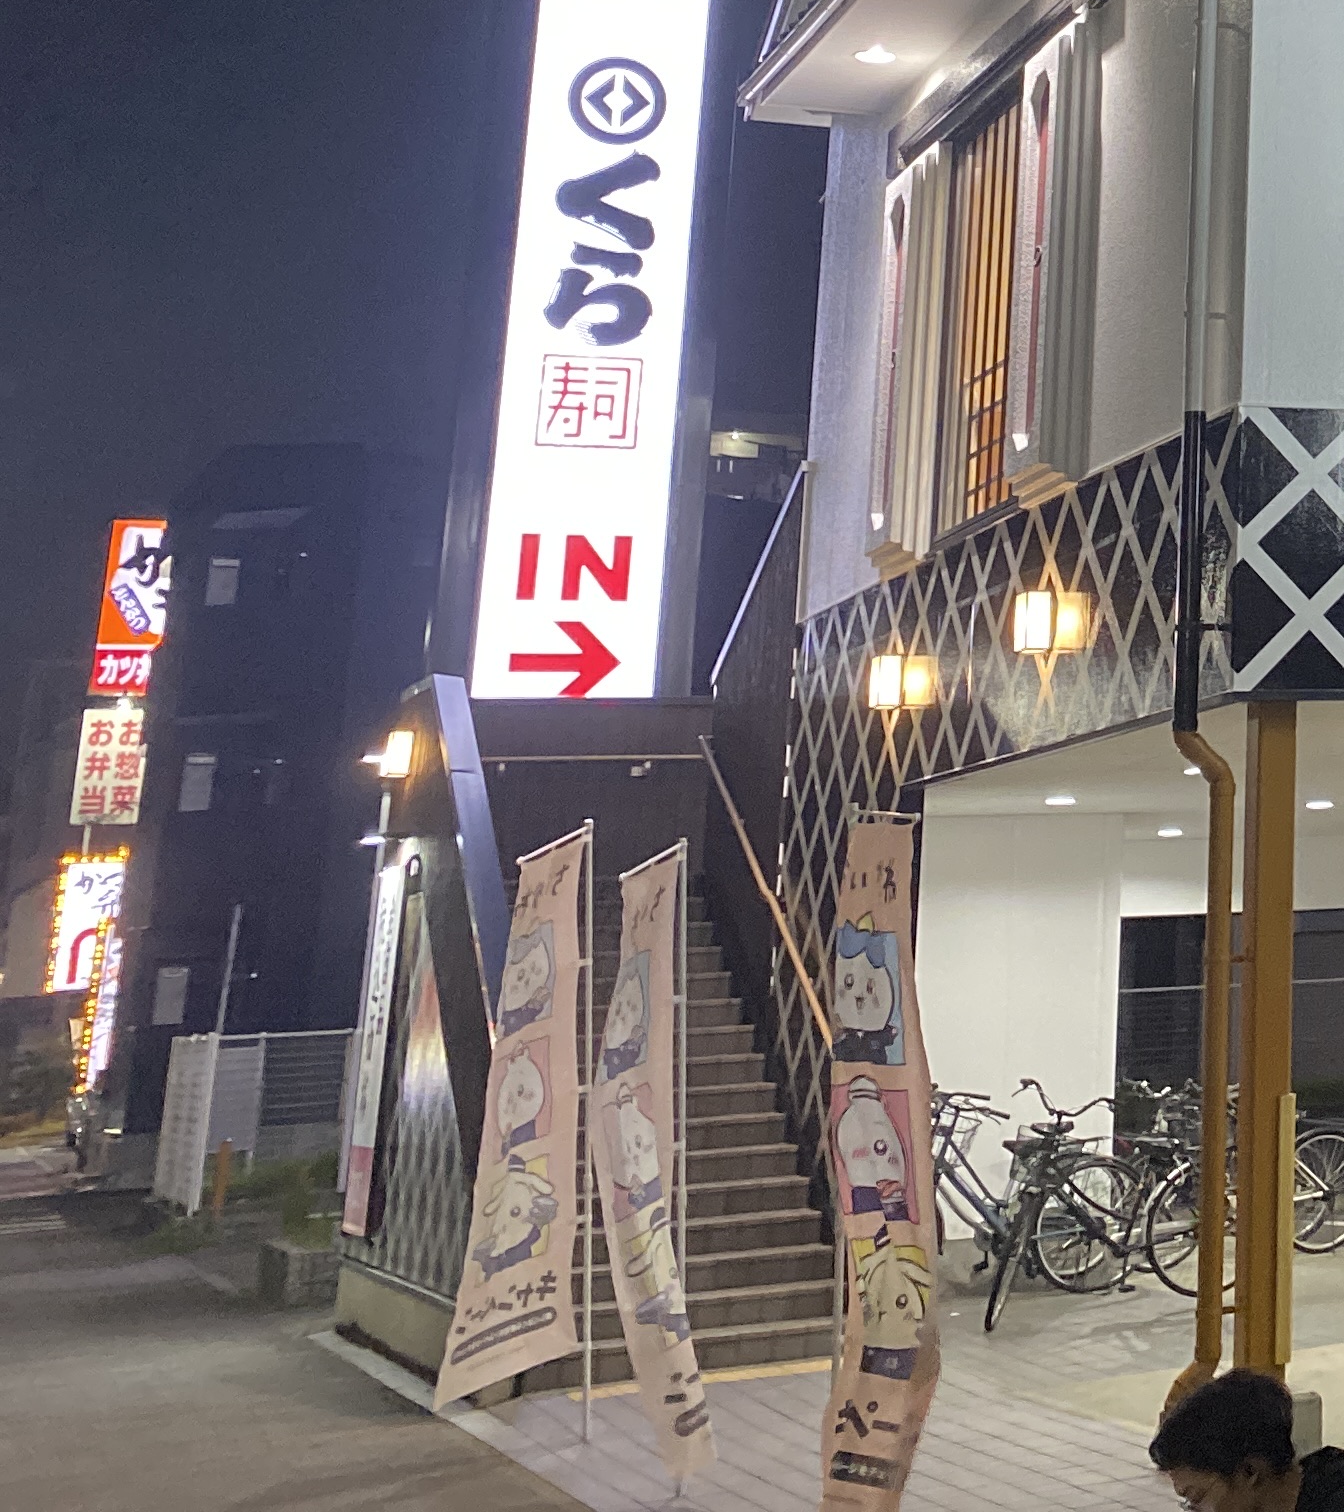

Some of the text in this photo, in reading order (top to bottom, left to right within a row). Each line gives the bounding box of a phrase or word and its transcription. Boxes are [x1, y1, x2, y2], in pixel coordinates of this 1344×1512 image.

[515, 533, 633, 601] IN
[79, 719, 115, 815] お弁当
